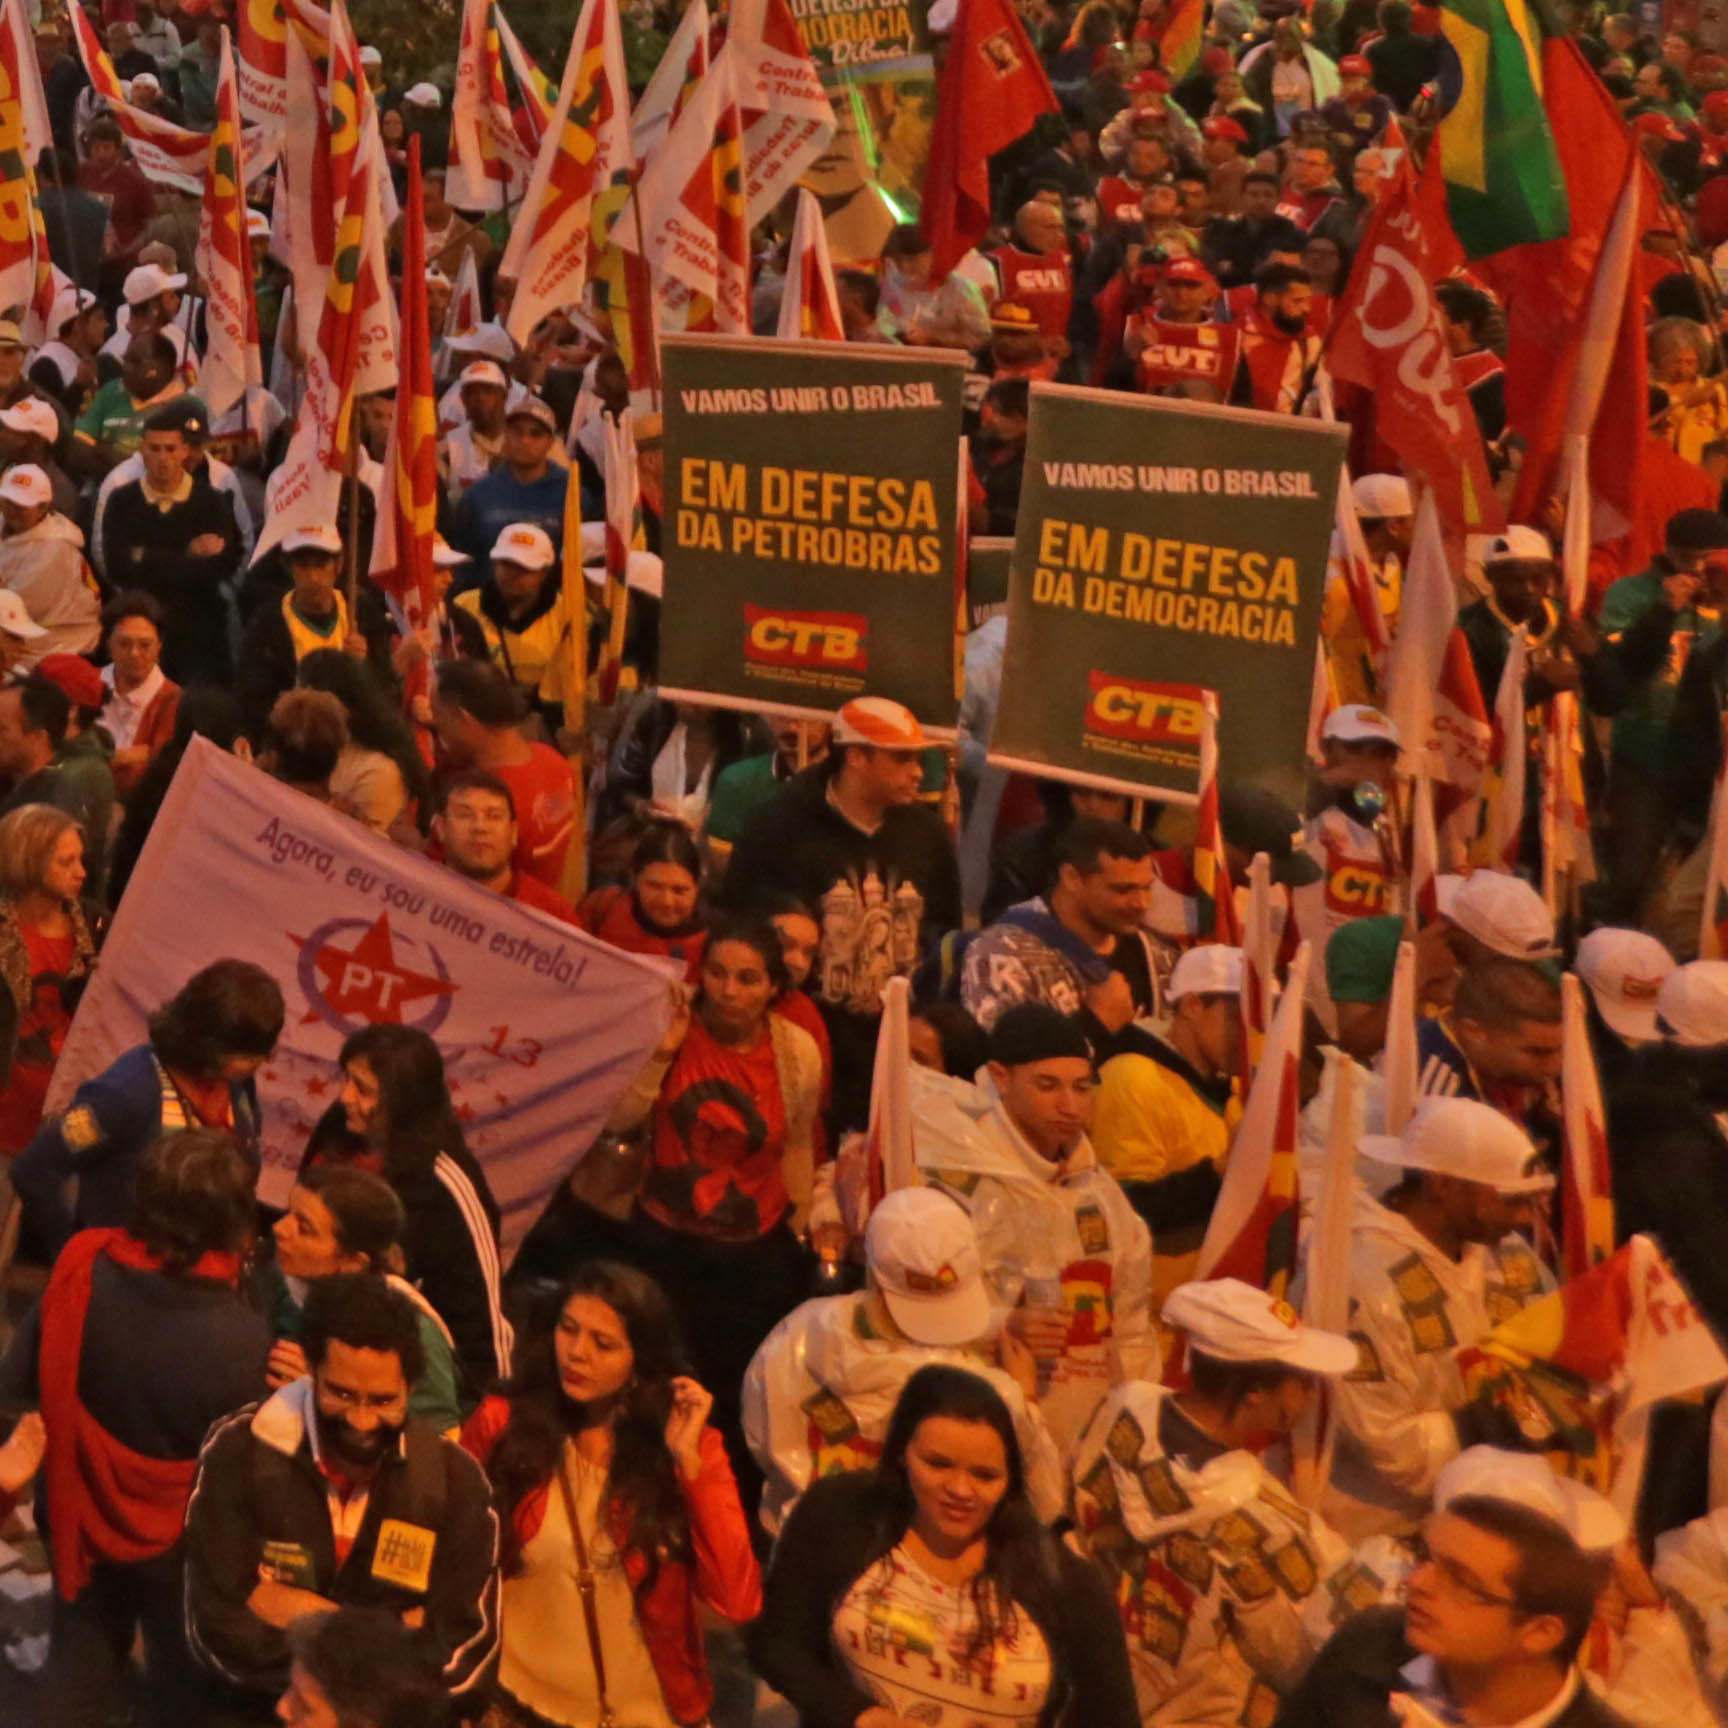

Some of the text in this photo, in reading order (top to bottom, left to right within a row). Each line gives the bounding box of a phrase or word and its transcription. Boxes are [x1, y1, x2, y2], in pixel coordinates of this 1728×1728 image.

[1116, 203, 1143, 221] CU
[1016, 270, 1064, 289] CUT
[1142, 346, 1216, 370] CUT
[681, 382, 942, 416] VAMOS UNIR O BRASIL
[680, 457, 939, 533] EM DEFESA
[1043, 461, 1319, 500] VAMOS UNIR O BRASIL
[676, 509, 942, 575] DA PETROBRAS
[1038, 517, 1300, 606] EM DEFESA
[1032, 567, 1298, 647] DA DEMOCRACIA
[749, 613, 863, 662] CTB
[1091, 683, 1206, 736] CTB
[255, 816, 588, 988] Agora, eu sou uma estrela!
[1330, 872, 1392, 904] CT
[338, 961, 405, 1009] PT
[480, 1024, 543, 1069] 13
